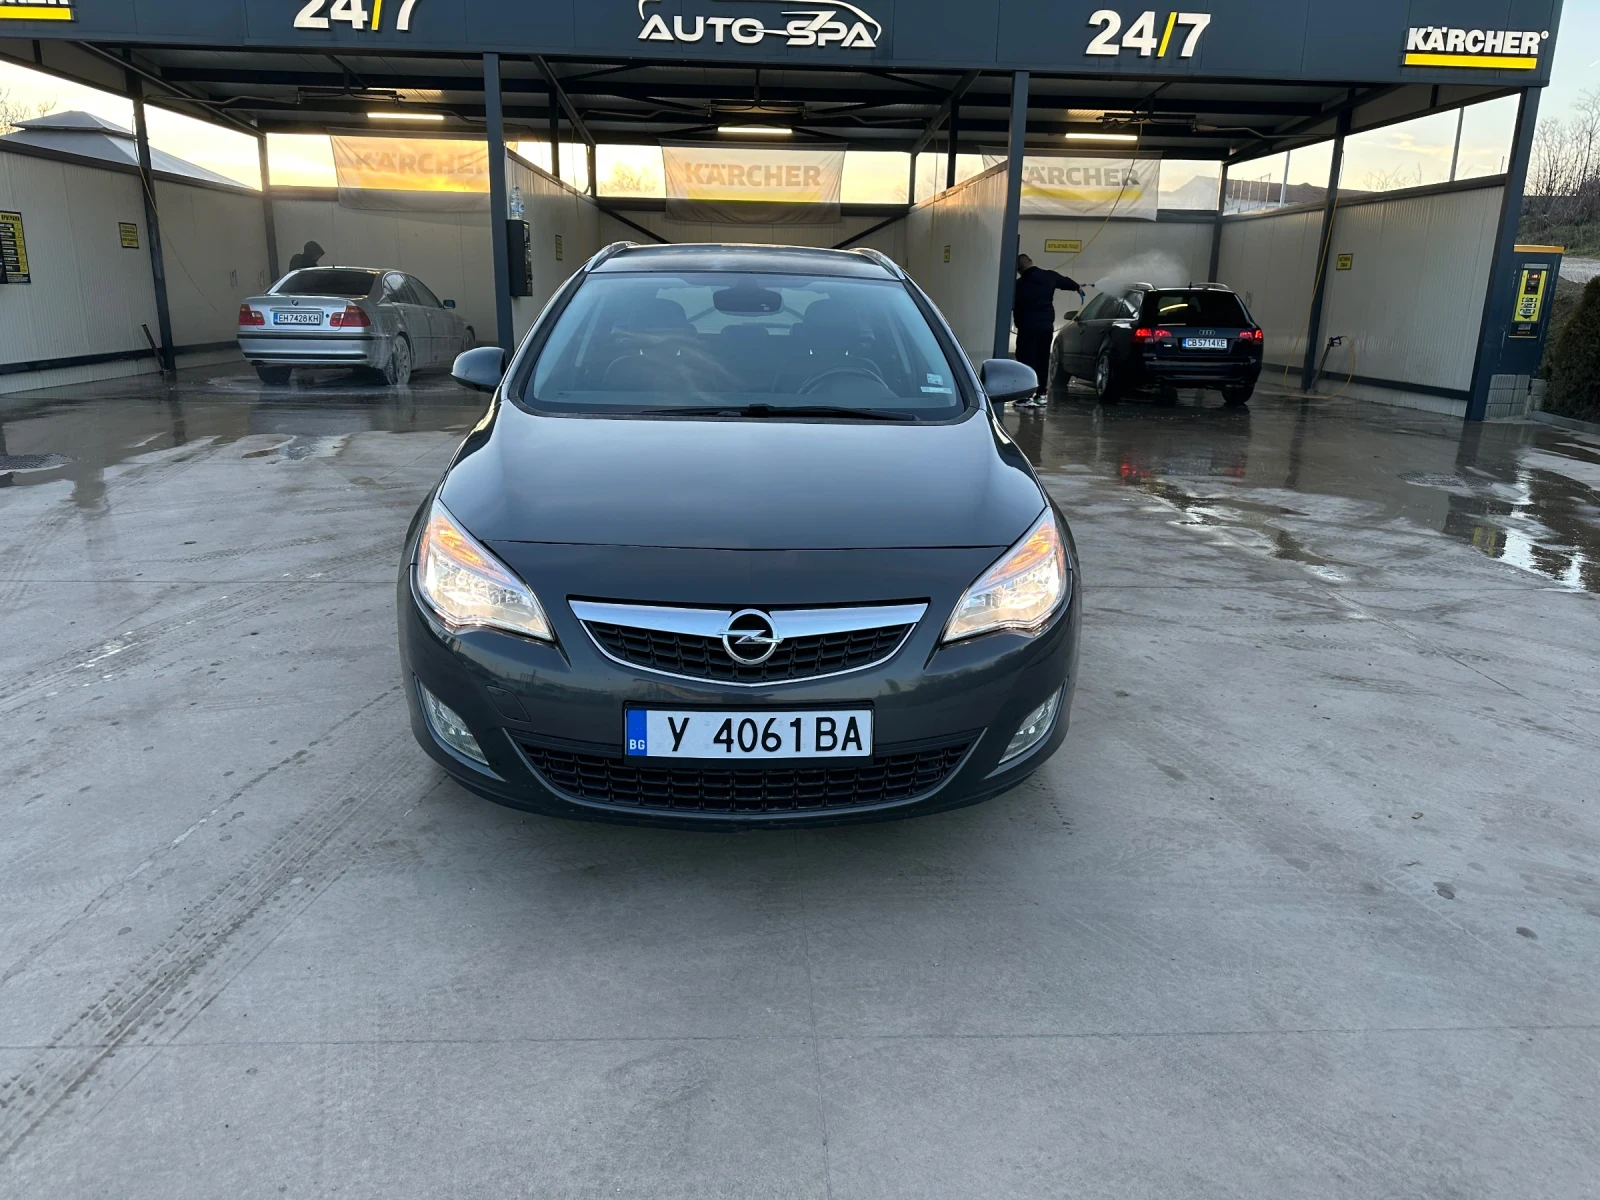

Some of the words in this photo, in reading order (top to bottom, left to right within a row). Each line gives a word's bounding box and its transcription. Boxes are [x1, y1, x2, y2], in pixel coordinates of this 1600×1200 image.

[638, 14, 764, 44] AUTO
[786, 17, 876, 48] SPA
[1085, 10, 1211, 58] 24/7
[1407, 26, 1541, 55] KÄRCHER
[684, 162, 821, 187] KÄRCHER
[1024, 165, 1141, 187] ÄRCHER
[629, 739, 646, 750] BG
